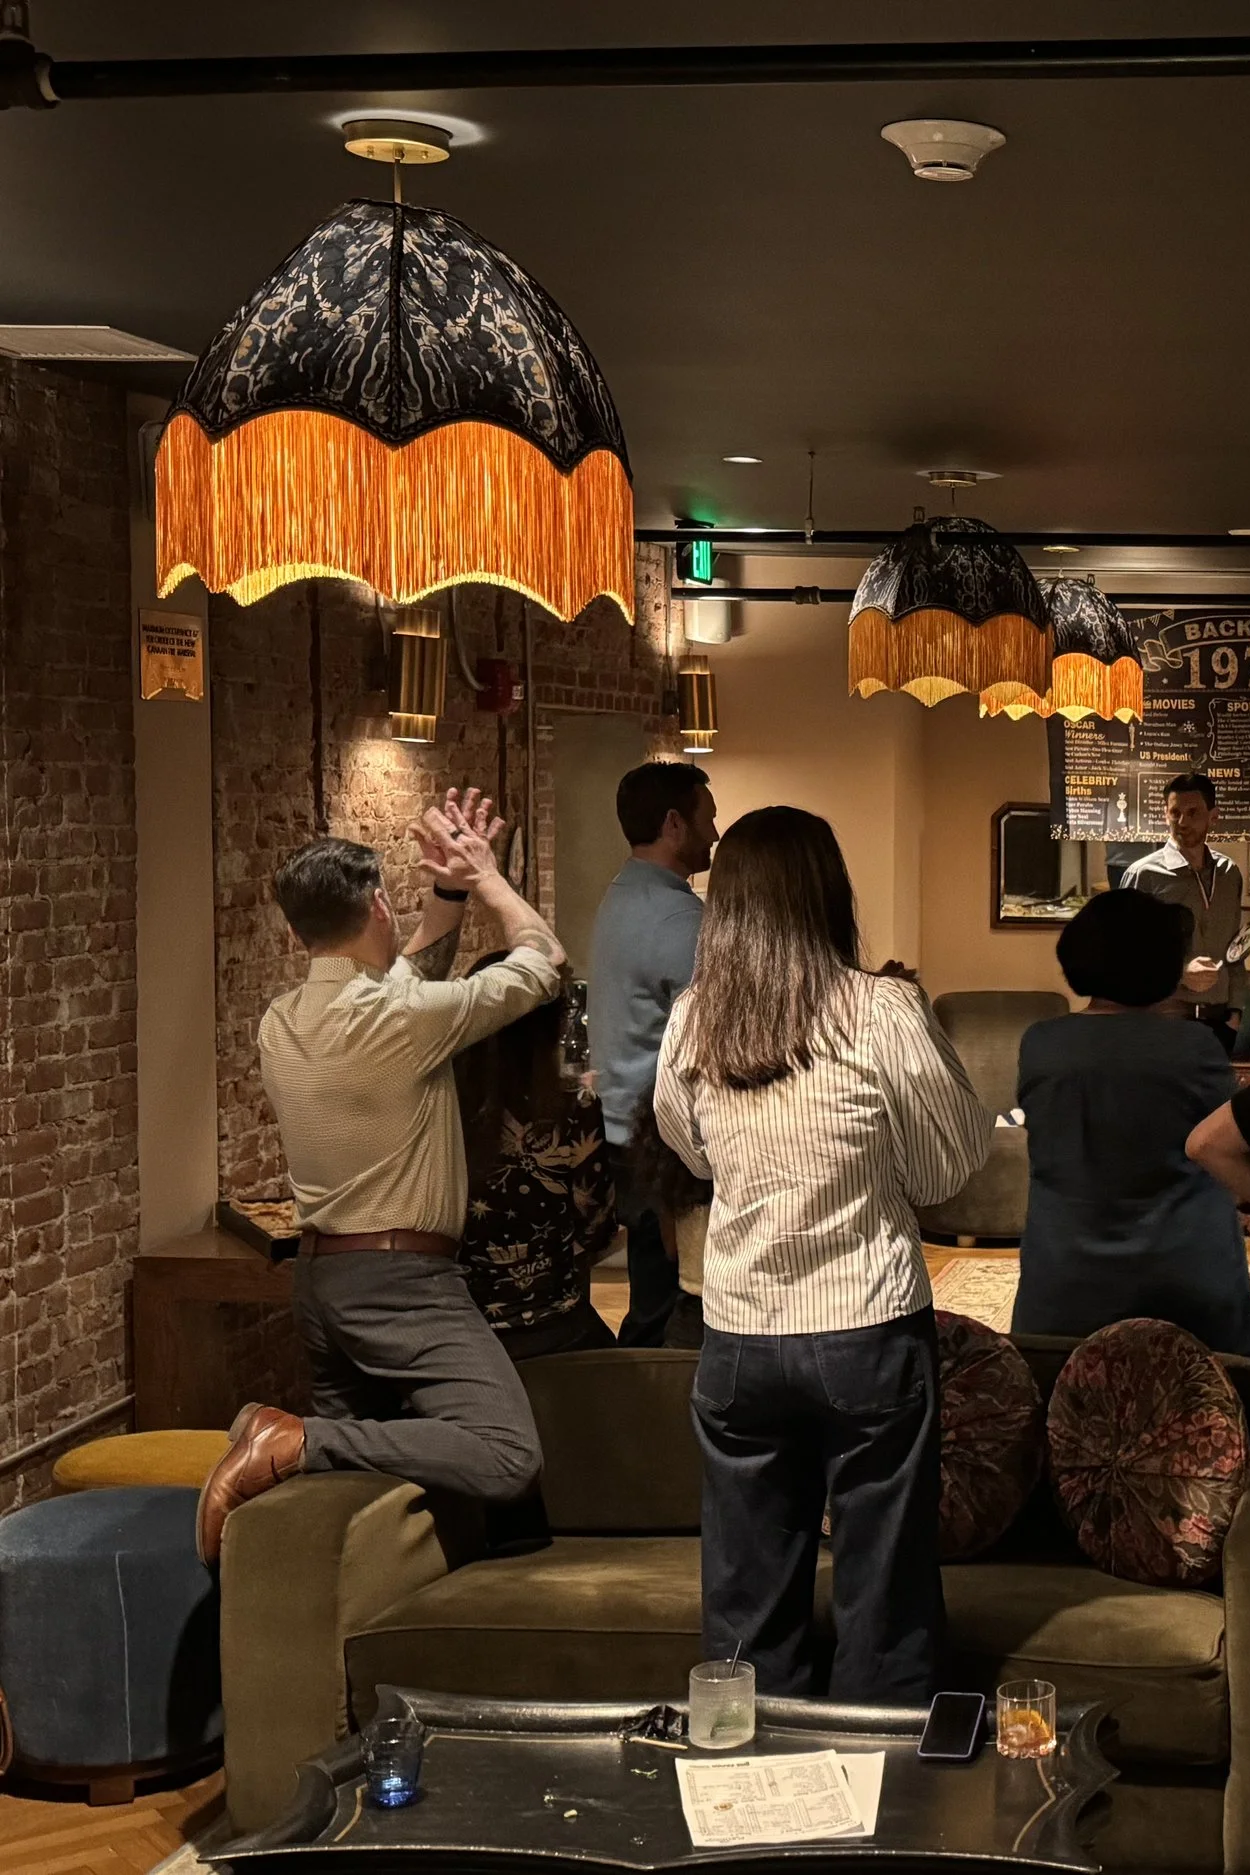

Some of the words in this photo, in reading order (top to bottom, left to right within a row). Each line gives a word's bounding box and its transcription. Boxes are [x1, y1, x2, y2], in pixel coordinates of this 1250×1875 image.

[1152, 699, 1196, 710] MOVIES
[1063, 719, 1096, 729] OSCAR
[1064, 730, 1106, 741] Winners
[1139, 751, 1151, 760] US
[1152, 751, 1189, 761] President
[1207, 768, 1241, 778] NEWS
[1064, 775, 1119, 786] CELEBRITY
[1065, 786, 1092, 796] Births
